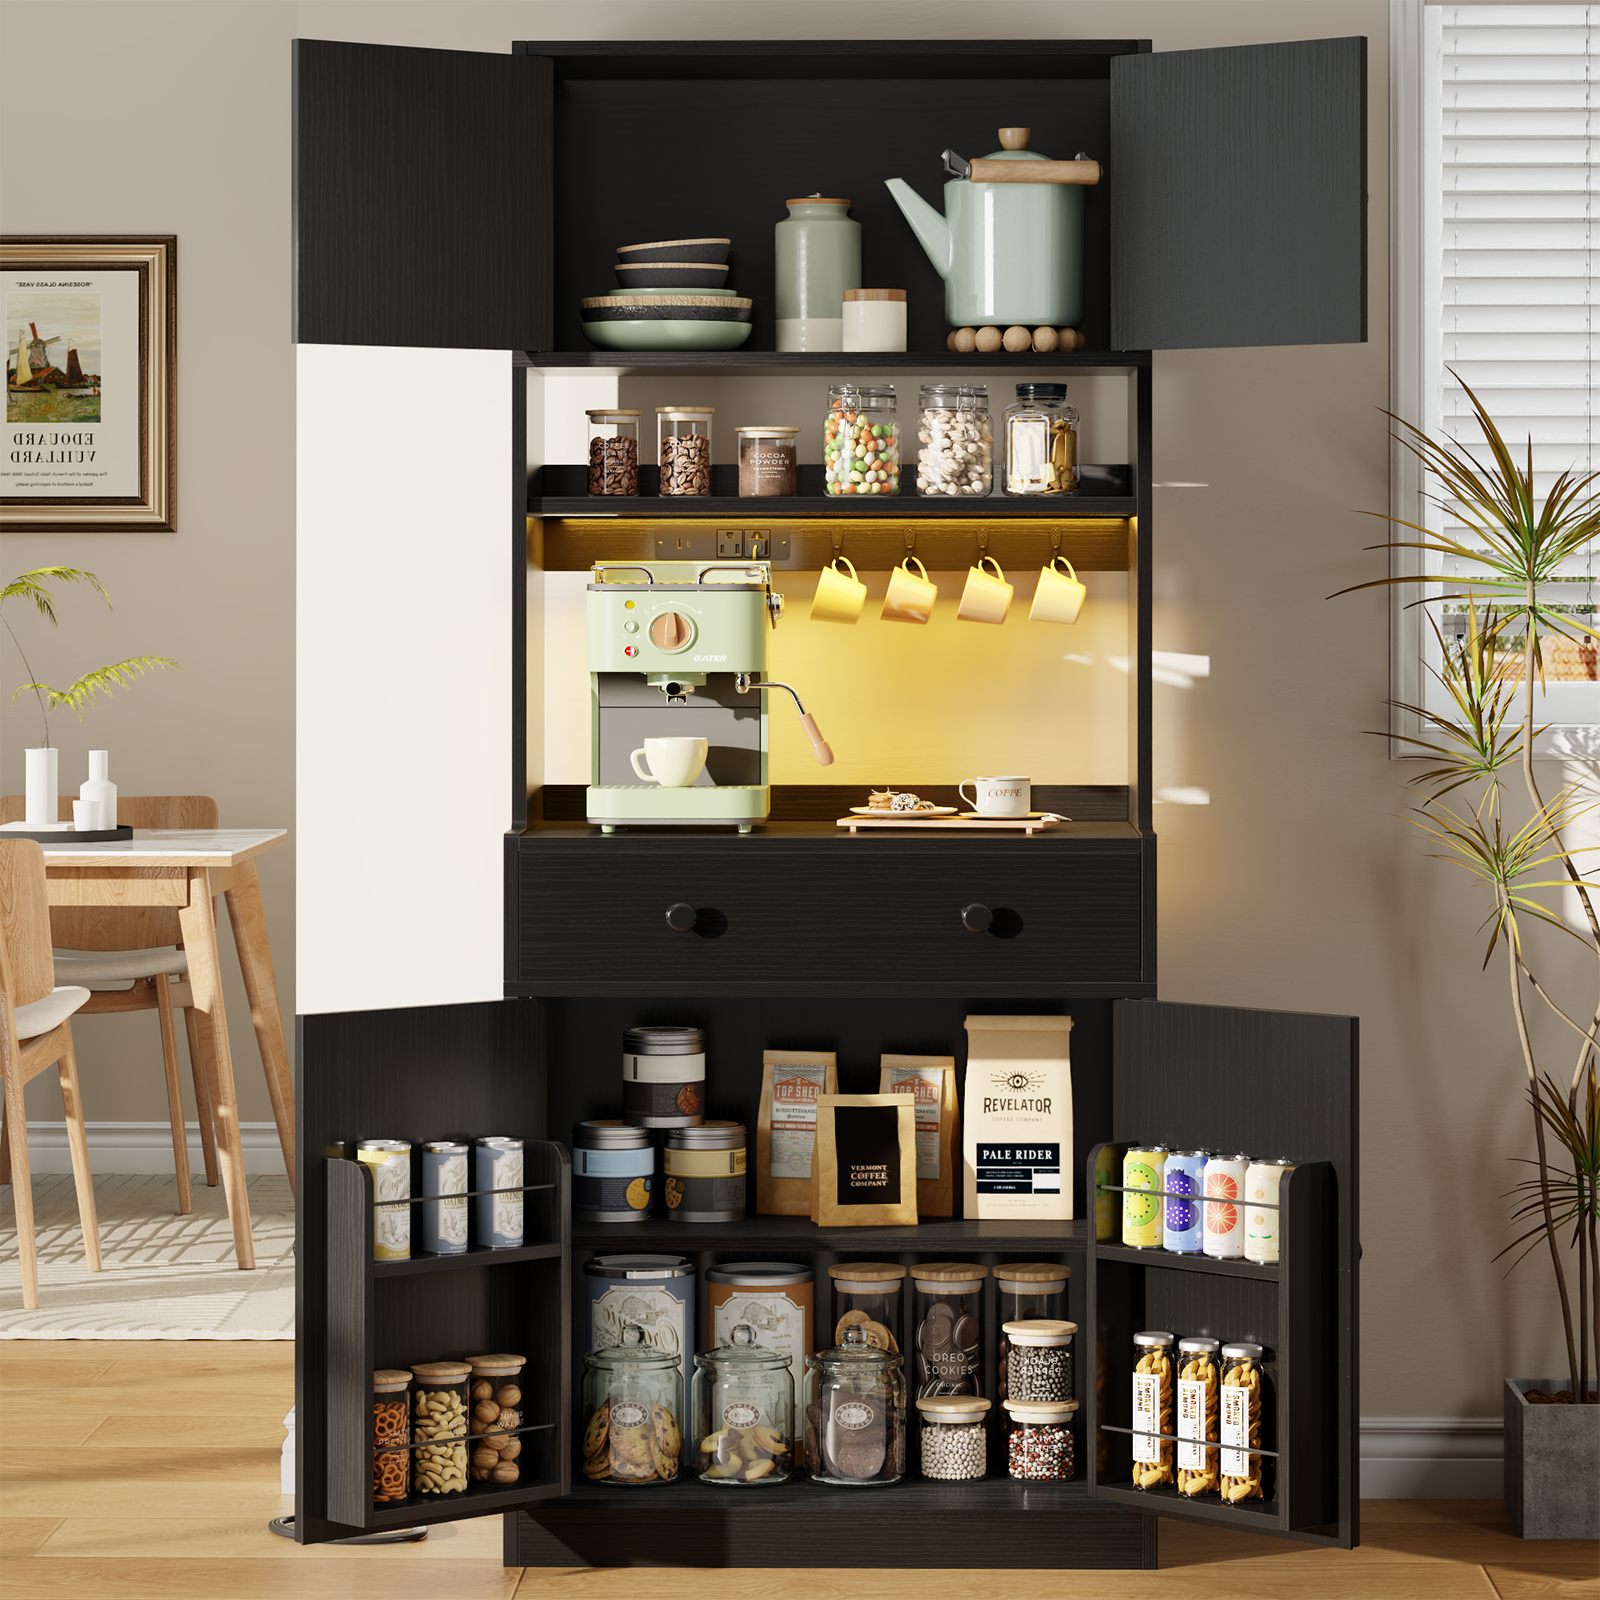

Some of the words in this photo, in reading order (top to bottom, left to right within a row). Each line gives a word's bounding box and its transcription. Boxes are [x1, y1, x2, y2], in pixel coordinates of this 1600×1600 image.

[776, 1085, 794, 1098] TOP
[983, 1097, 1052, 1115] REVELATOR
[983, 1149, 1012, 1160] PALE
[1015, 1149, 1053, 1160] RIDER
[850, 1172, 888, 1180] COFFEE
[933, 1352, 965, 1362] OREO
[925, 1365, 973, 1375] COOKIES
[1144, 1382, 1152, 1413] SMOKED
[1189, 1388, 1197, 1420] SMOKED
[1232, 1394, 1240, 1426] SMOKED
